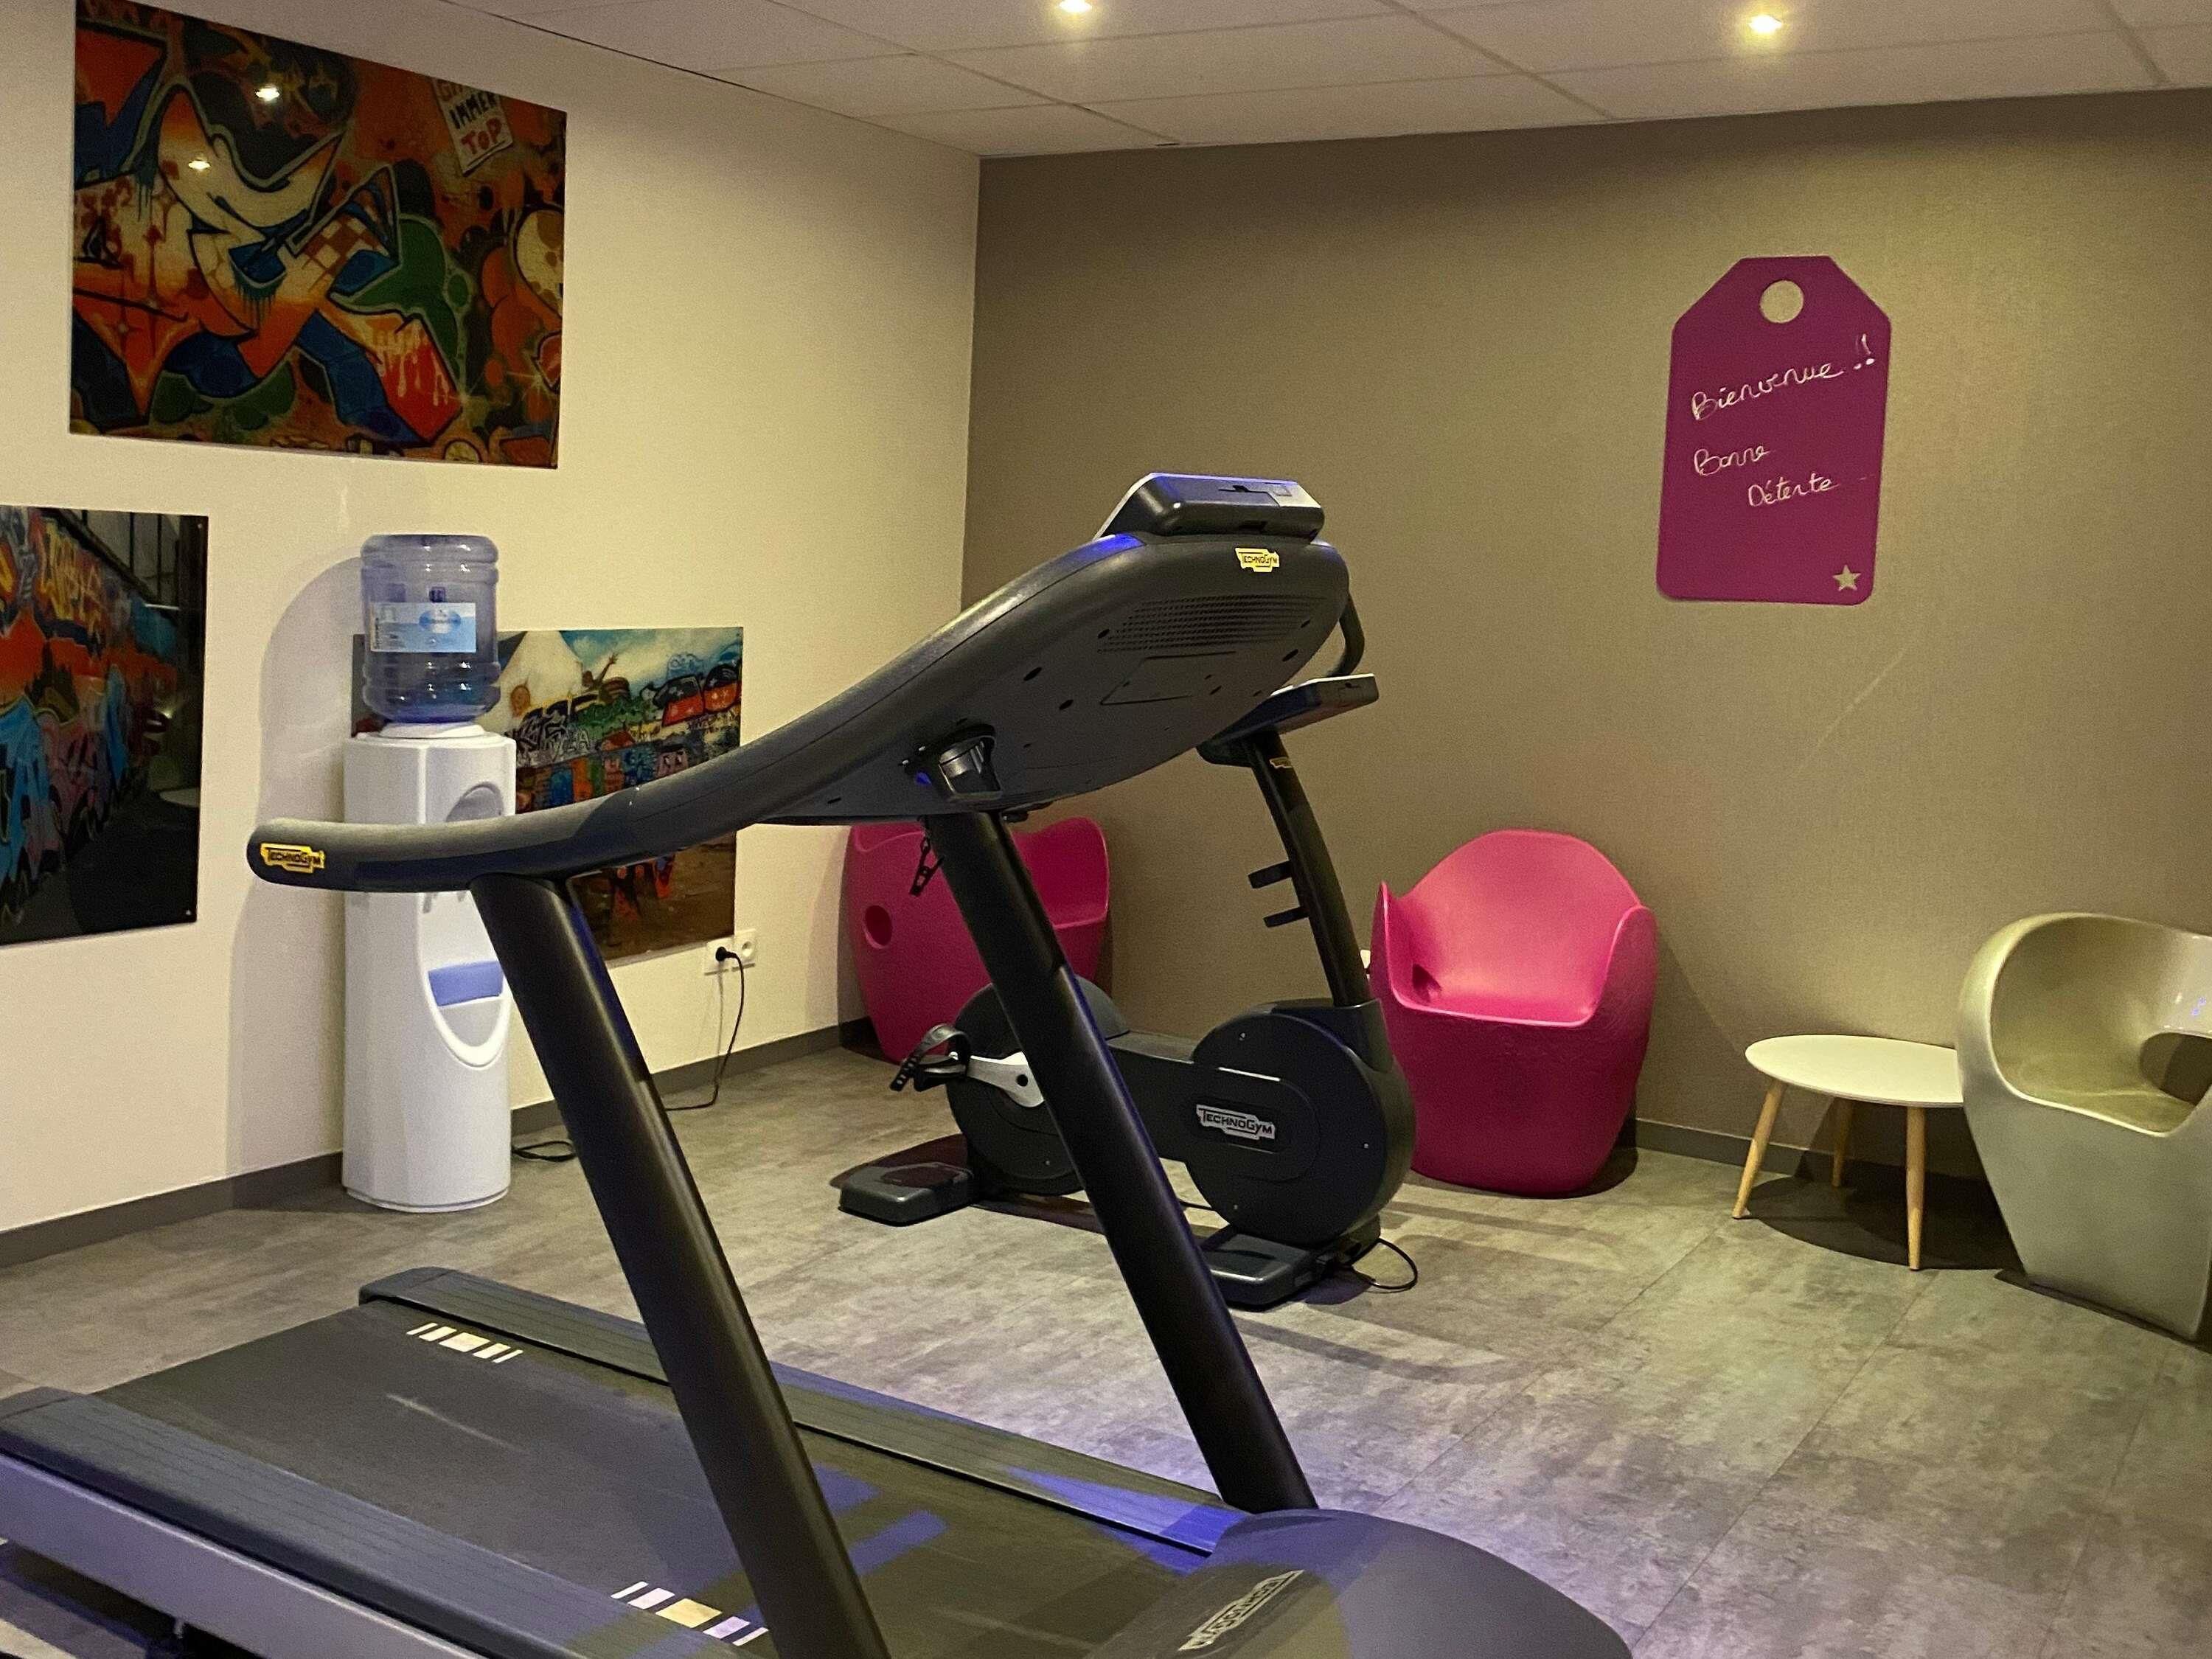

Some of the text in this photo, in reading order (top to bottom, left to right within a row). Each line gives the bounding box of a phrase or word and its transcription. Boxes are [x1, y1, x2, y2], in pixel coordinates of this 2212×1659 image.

[1691, 363, 1844, 421] Bienvenue
[1694, 445, 1772, 476] Bonne
[1748, 473, 1841, 507] Détente
[1197, 1107, 1273, 1135] TECHNOGYM
